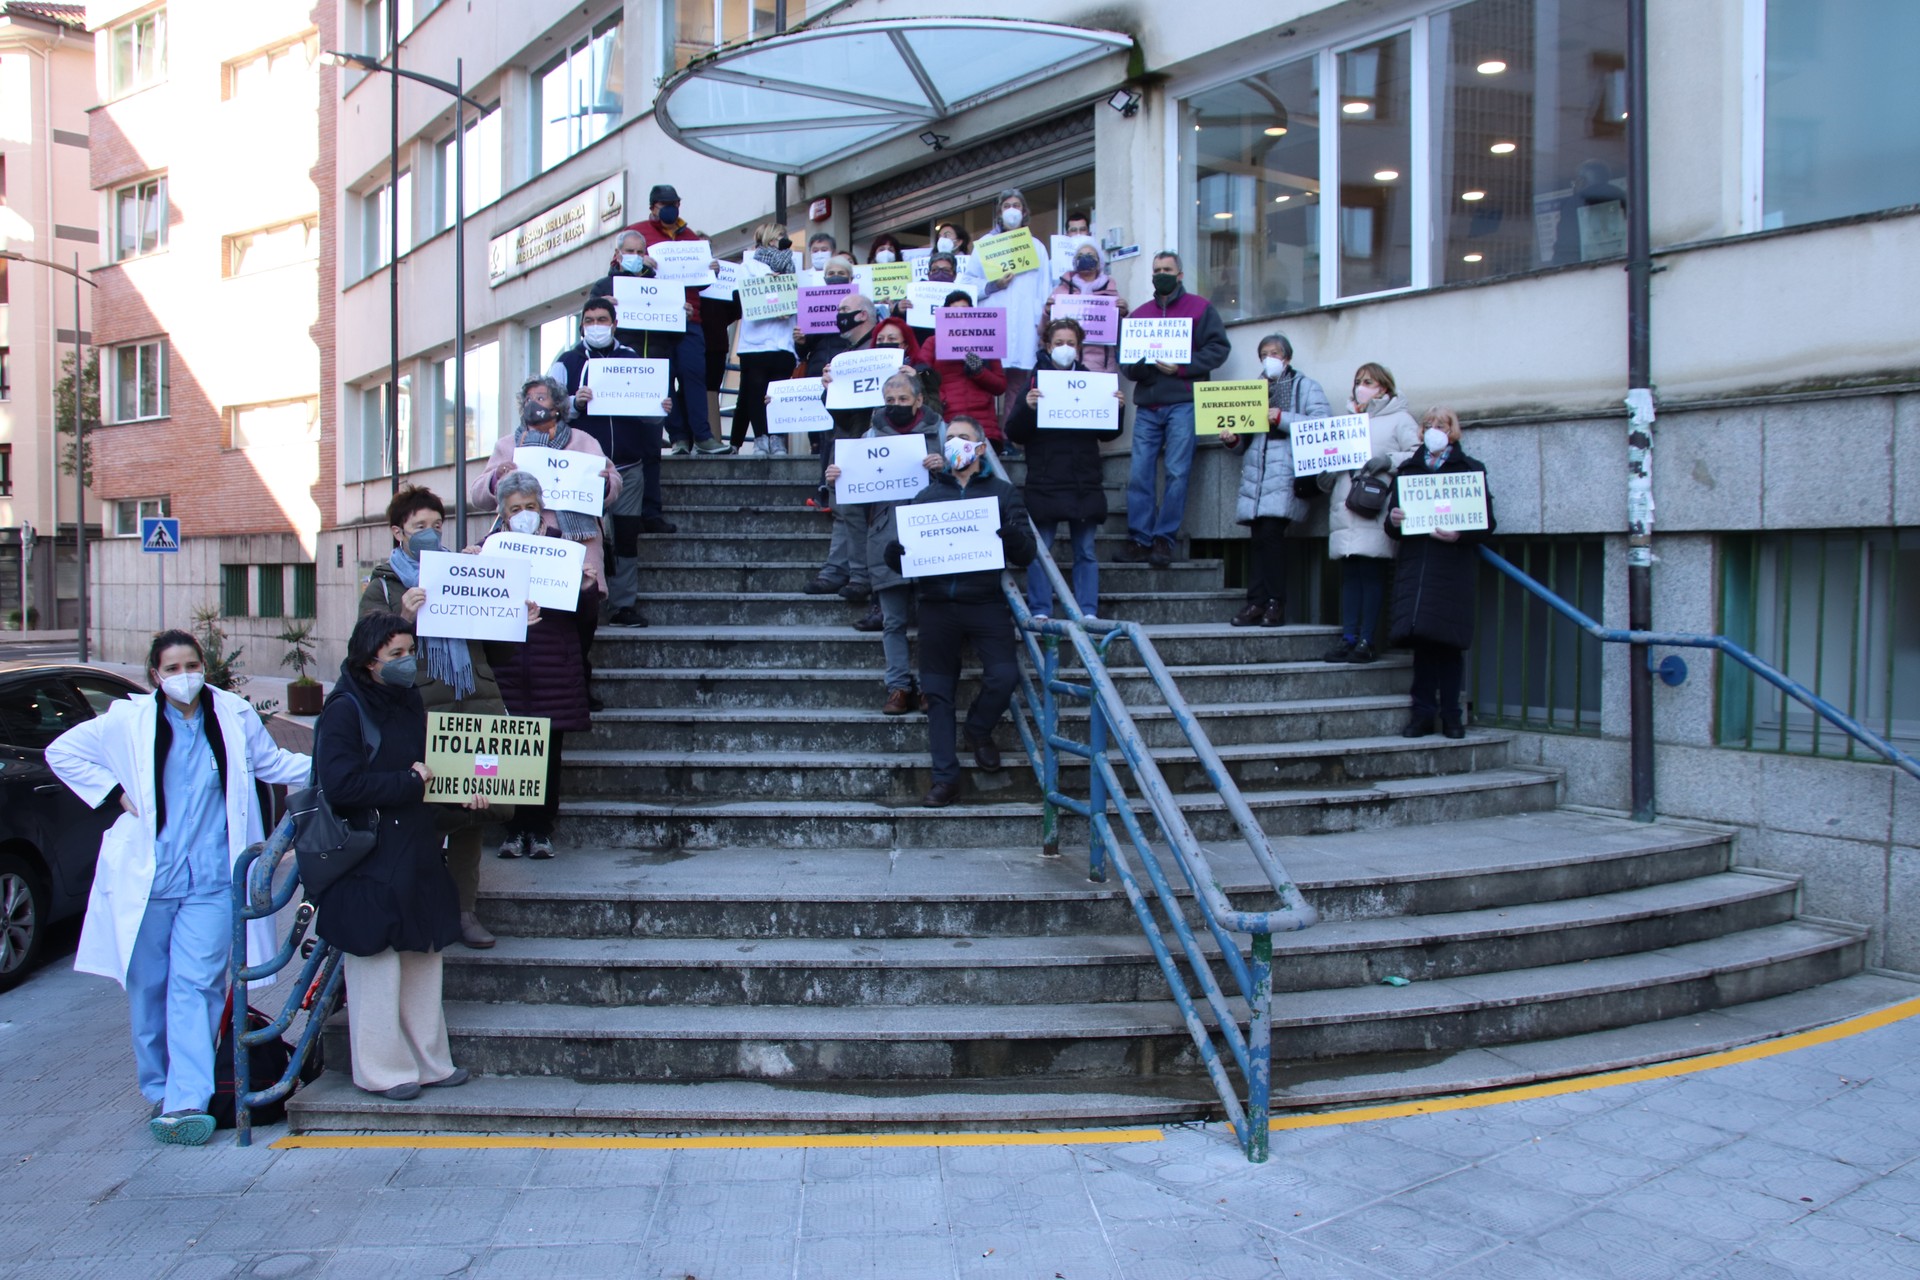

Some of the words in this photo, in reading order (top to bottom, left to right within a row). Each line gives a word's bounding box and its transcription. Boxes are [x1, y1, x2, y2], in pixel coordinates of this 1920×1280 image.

[985, 244, 1030, 260] AURREKONTUA
[1000, 260, 1016, 272] 25
[1018, 256, 1030, 266] %
[743, 278, 765, 286] LEHEN
[766, 275, 794, 283] ARRETA
[640, 286, 658, 294] NO
[742, 283, 798, 297] ITOLARRIAN
[806, 289, 851, 297] KALITATEZKO
[875, 286, 890, 296] 25
[893, 286, 904, 294] %
[746, 307, 762, 317] ZURE
[762, 303, 788, 313] OSASUNA
[622, 312, 678, 322] RECORTES
[1126, 329, 1189, 338] ITOLARRIAN
[834, 358, 858, 368] LEHEN
[859, 354, 894, 364] ARRETAN
[1124, 350, 1142, 359] ZURE
[1143, 350, 1173, 359] OSASUNA
[1175, 350, 1188, 359] ERE
[836, 364, 893, 376] MURRIZKETARIK
[854, 377, 880, 393] EZ!
[1067, 380, 1087, 389] NO
[1202, 400, 1262, 408] AURREKONTUA
[1049, 409, 1110, 419] RECORTES
[1217, 415, 1236, 428] 25
[1240, 415, 1255, 427] %
[1298, 421, 1326, 433] LEHEN
[1330, 416, 1363, 429] ARRETA
[1295, 427, 1366, 446] ITOLARRIAN
[867, 447, 890, 459] NO
[548, 458, 569, 468] NO
[1297, 458, 1316, 471] ZURE
[1318, 454, 1352, 468] OSASUNA
[1354, 452, 1368, 462] ERE
[848, 477, 919, 494] RECORTES
[1407, 477, 1436, 488] LEHEN
[1442, 475, 1478, 485] ARRETA
[542, 489, 594, 502] CORTES
[1404, 486, 1482, 501] ITOLARRIAN
[1405, 516, 1426, 528] ZURE
[1428, 513, 1466, 526] OSASUNA
[1468, 512, 1483, 524] ERE
[920, 525, 979, 538] PERTSONAL
[500, 541, 567, 558] INBERTSIO
[913, 556, 944, 566] LEHEN
[947, 550, 992, 562] ARRETAN
[450, 566, 505, 579] OSASUN
[530, 577, 568, 588] RRETAN
[442, 584, 510, 598] PUBLIKOA
[430, 603, 520, 618] GUZTIONTZAT
[439, 716, 482, 732] LEHEN
[490, 719, 541, 736] ARRETA
[432, 735, 544, 756] ITOLARRIAN
[429, 776, 459, 794] ZURE
[463, 777, 515, 796] OSASUNA
[520, 779, 541, 796] ERE
